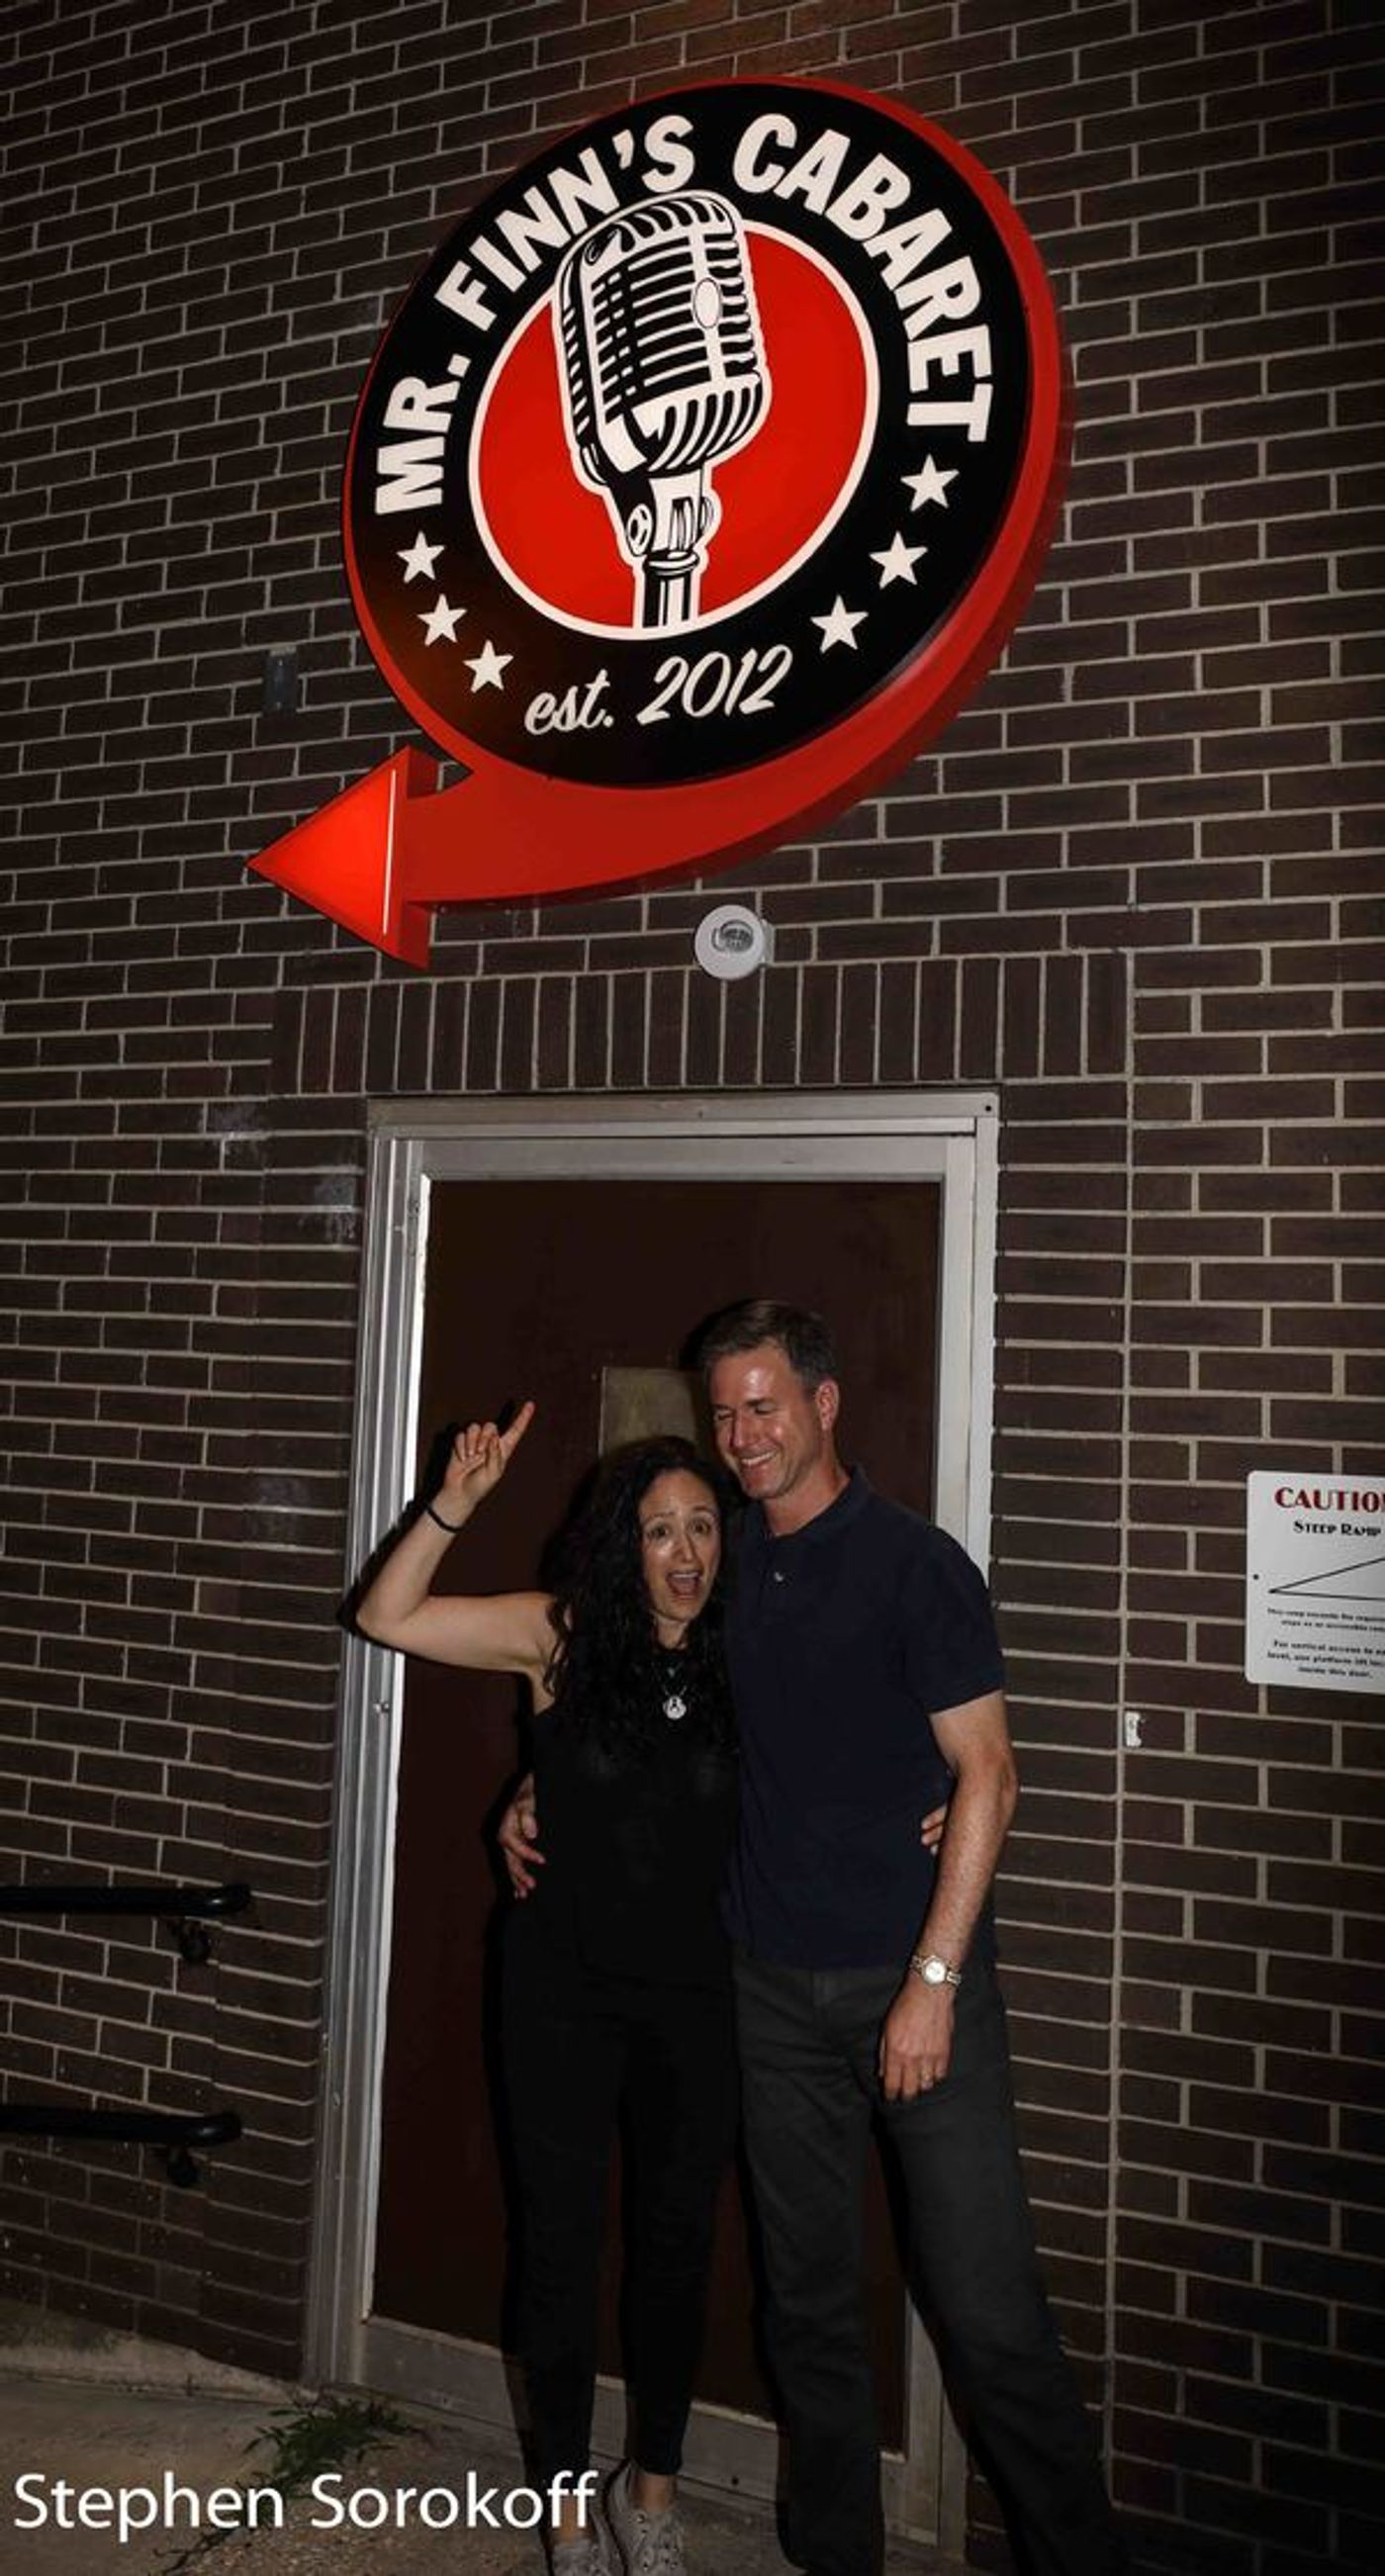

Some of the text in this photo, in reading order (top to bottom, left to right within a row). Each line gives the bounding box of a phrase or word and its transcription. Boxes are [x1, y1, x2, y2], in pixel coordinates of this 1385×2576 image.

[375, 112, 994, 514] MR. FINN'S CABARET
[524, 643, 793, 734] est. 2012
